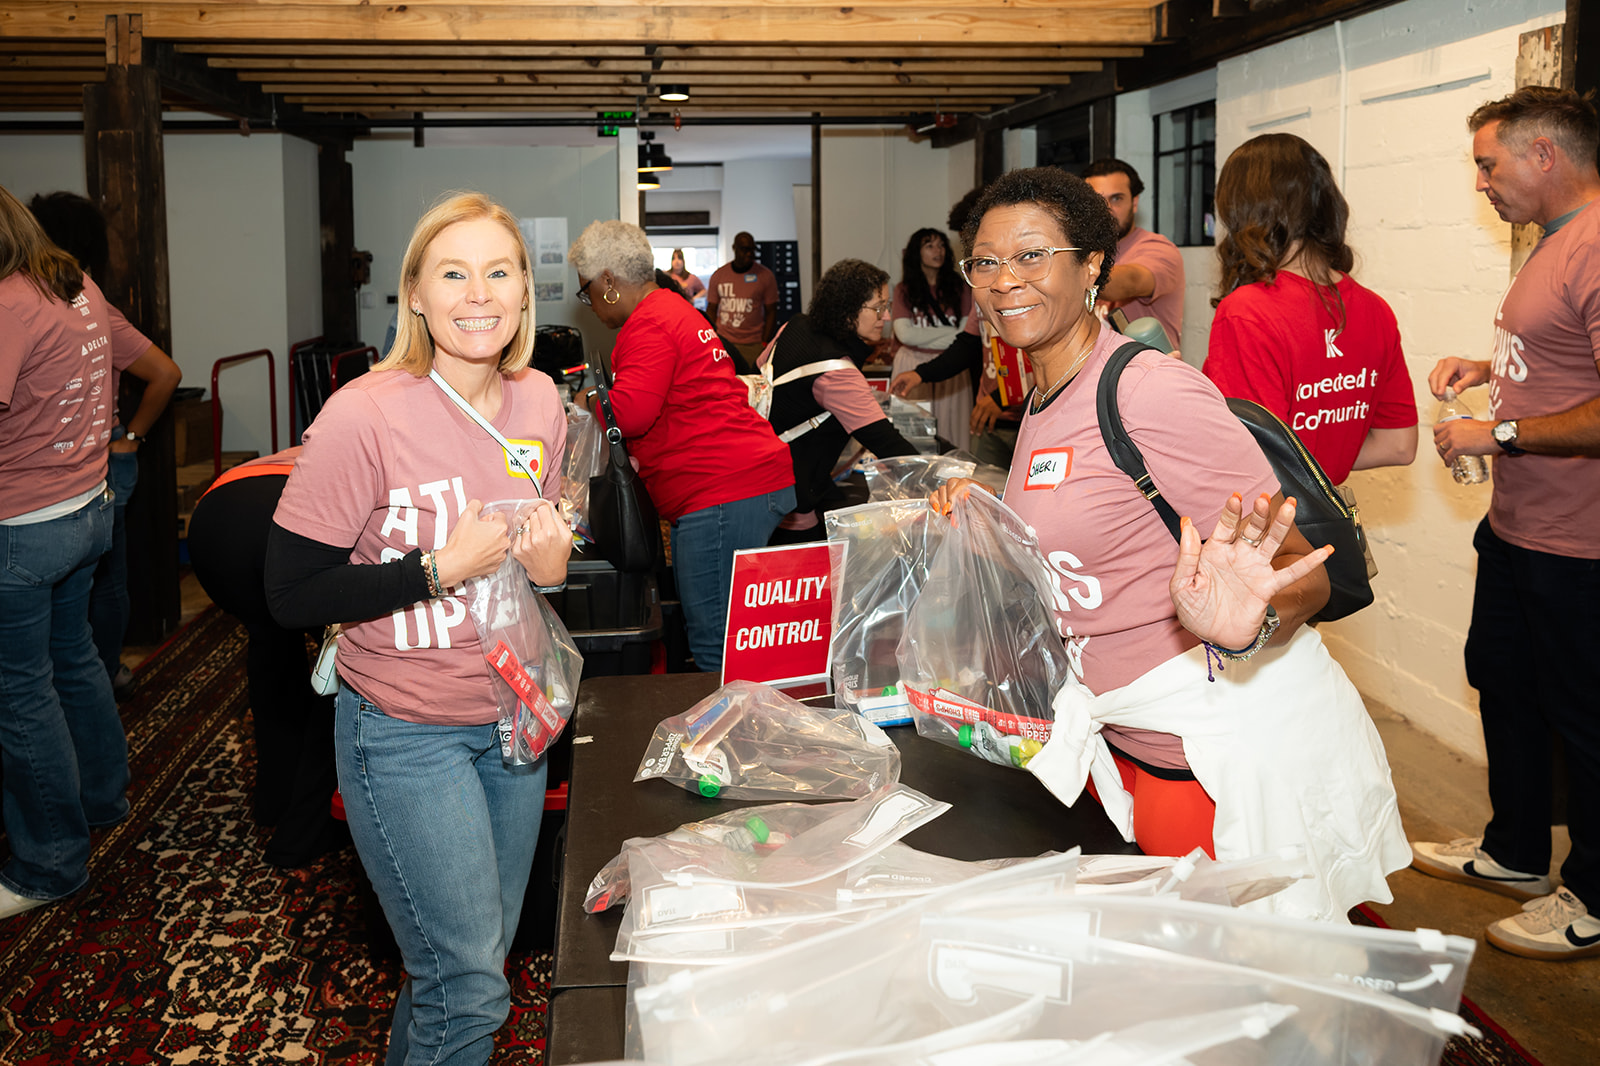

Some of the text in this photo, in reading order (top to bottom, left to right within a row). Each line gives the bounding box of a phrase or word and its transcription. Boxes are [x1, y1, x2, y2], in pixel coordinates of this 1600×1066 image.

[87, 335, 108, 352] DELTA
[1029, 460, 1057, 478] SHERI
[744, 575, 828, 608] QUALITY
[392, 596, 467, 651] UP
[735, 618, 823, 651] CONTROL
